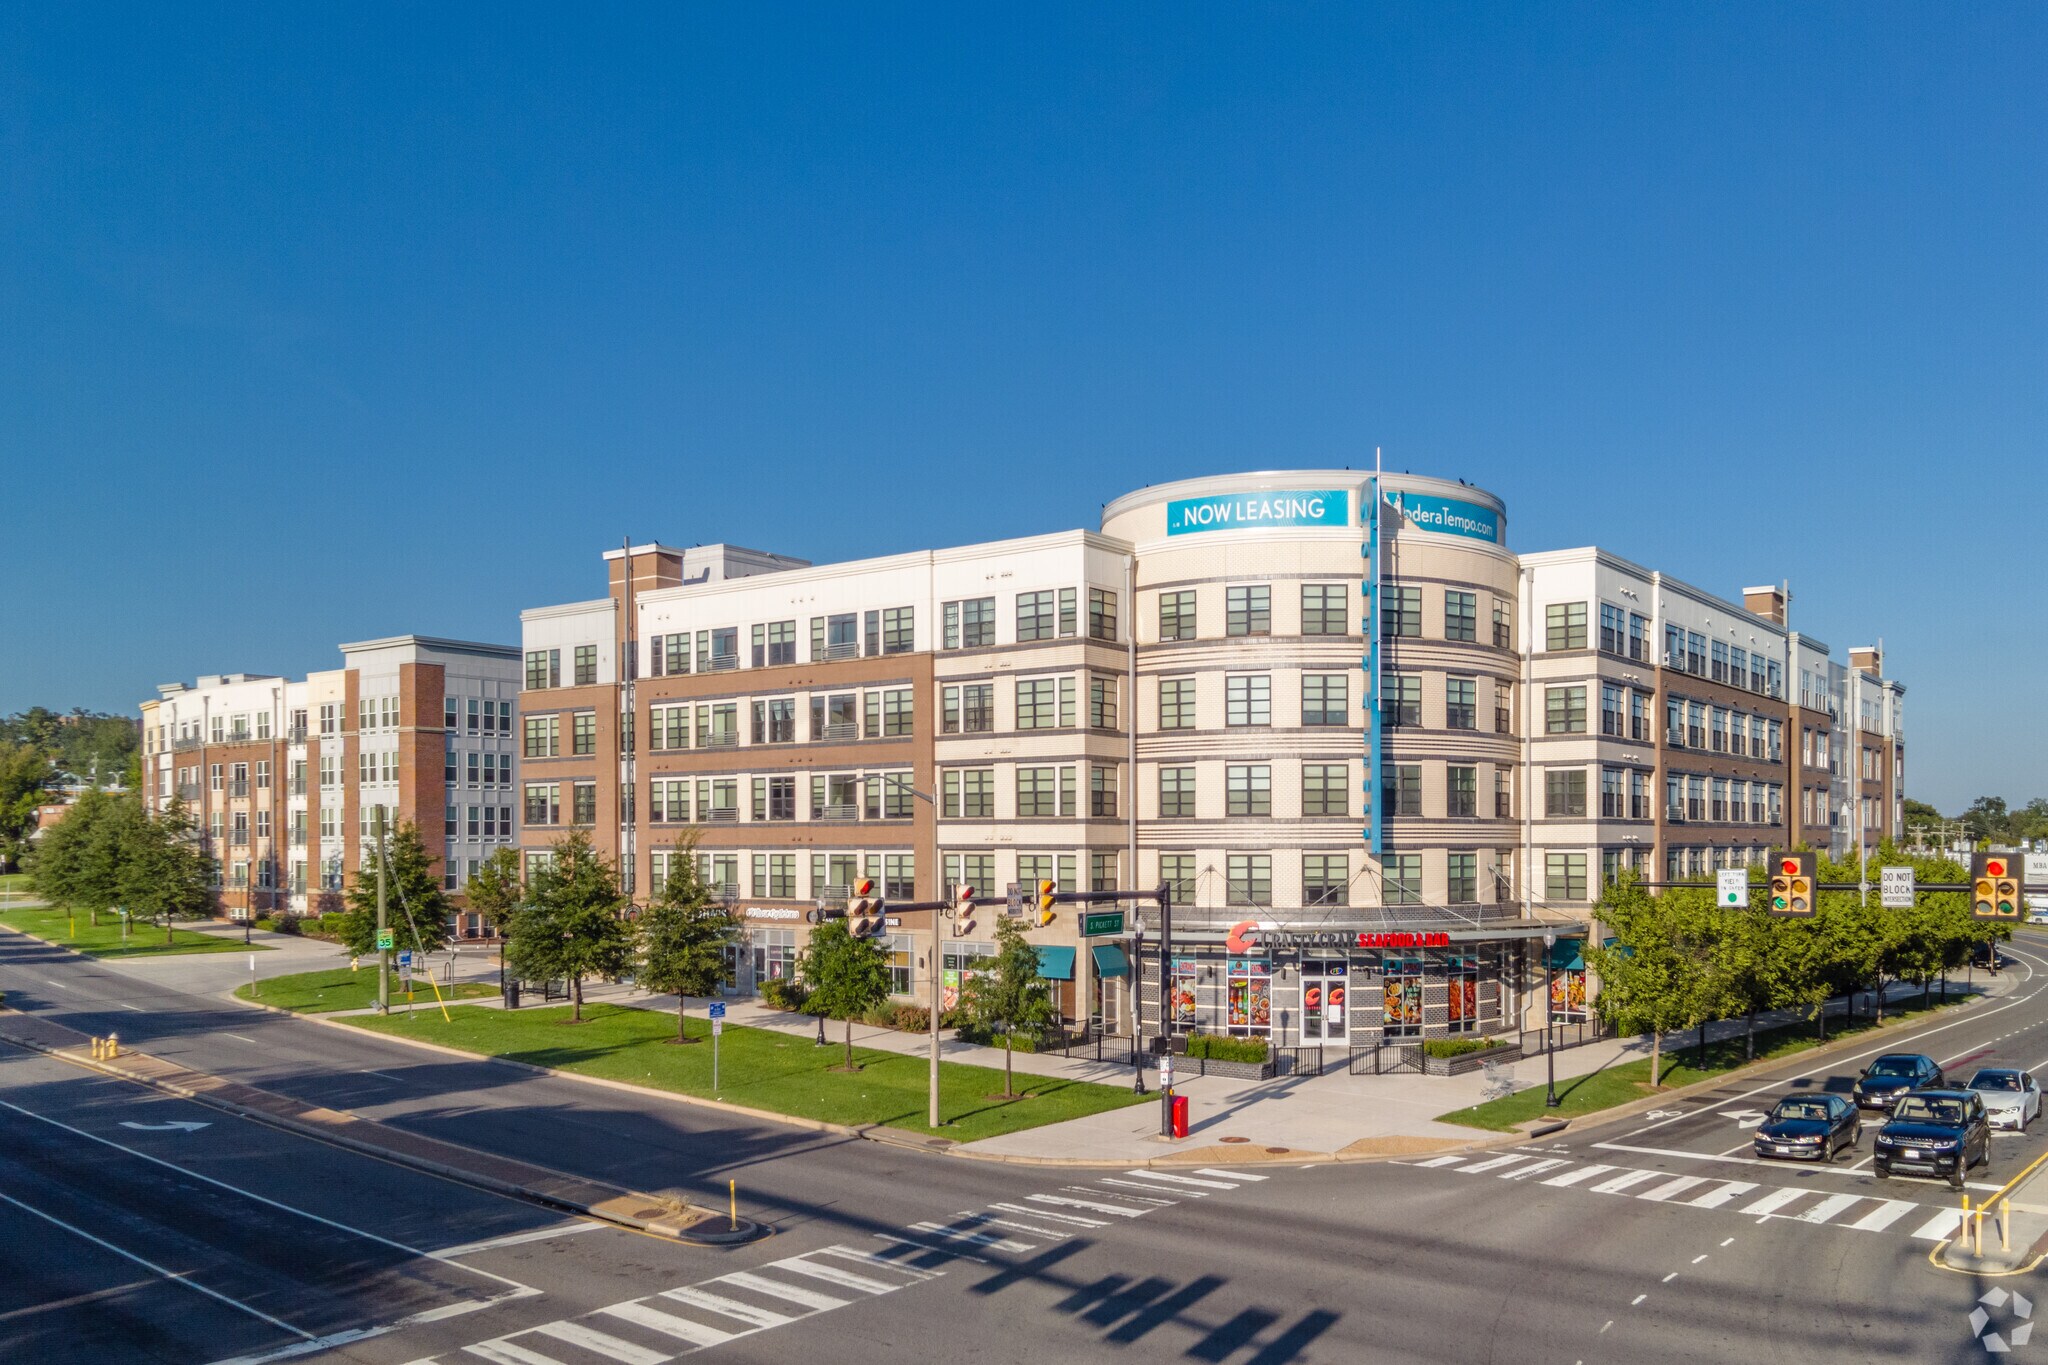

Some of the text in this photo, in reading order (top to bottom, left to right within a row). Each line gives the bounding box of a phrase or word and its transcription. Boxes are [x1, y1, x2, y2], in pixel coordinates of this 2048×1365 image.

[1184, 498, 1326, 527] NOW LEASING
[1404, 503, 1493, 537] oderaTempo.com
[1883, 873, 1911, 881] DO NOT
[1883, 885, 1911, 894] BLOCK
[1095, 920, 1113, 929] PICKETT
[379, 938, 392, 947] 35
[1261, 930, 1449, 950] CRAFTY CRAB SEAFOOD & BAR
